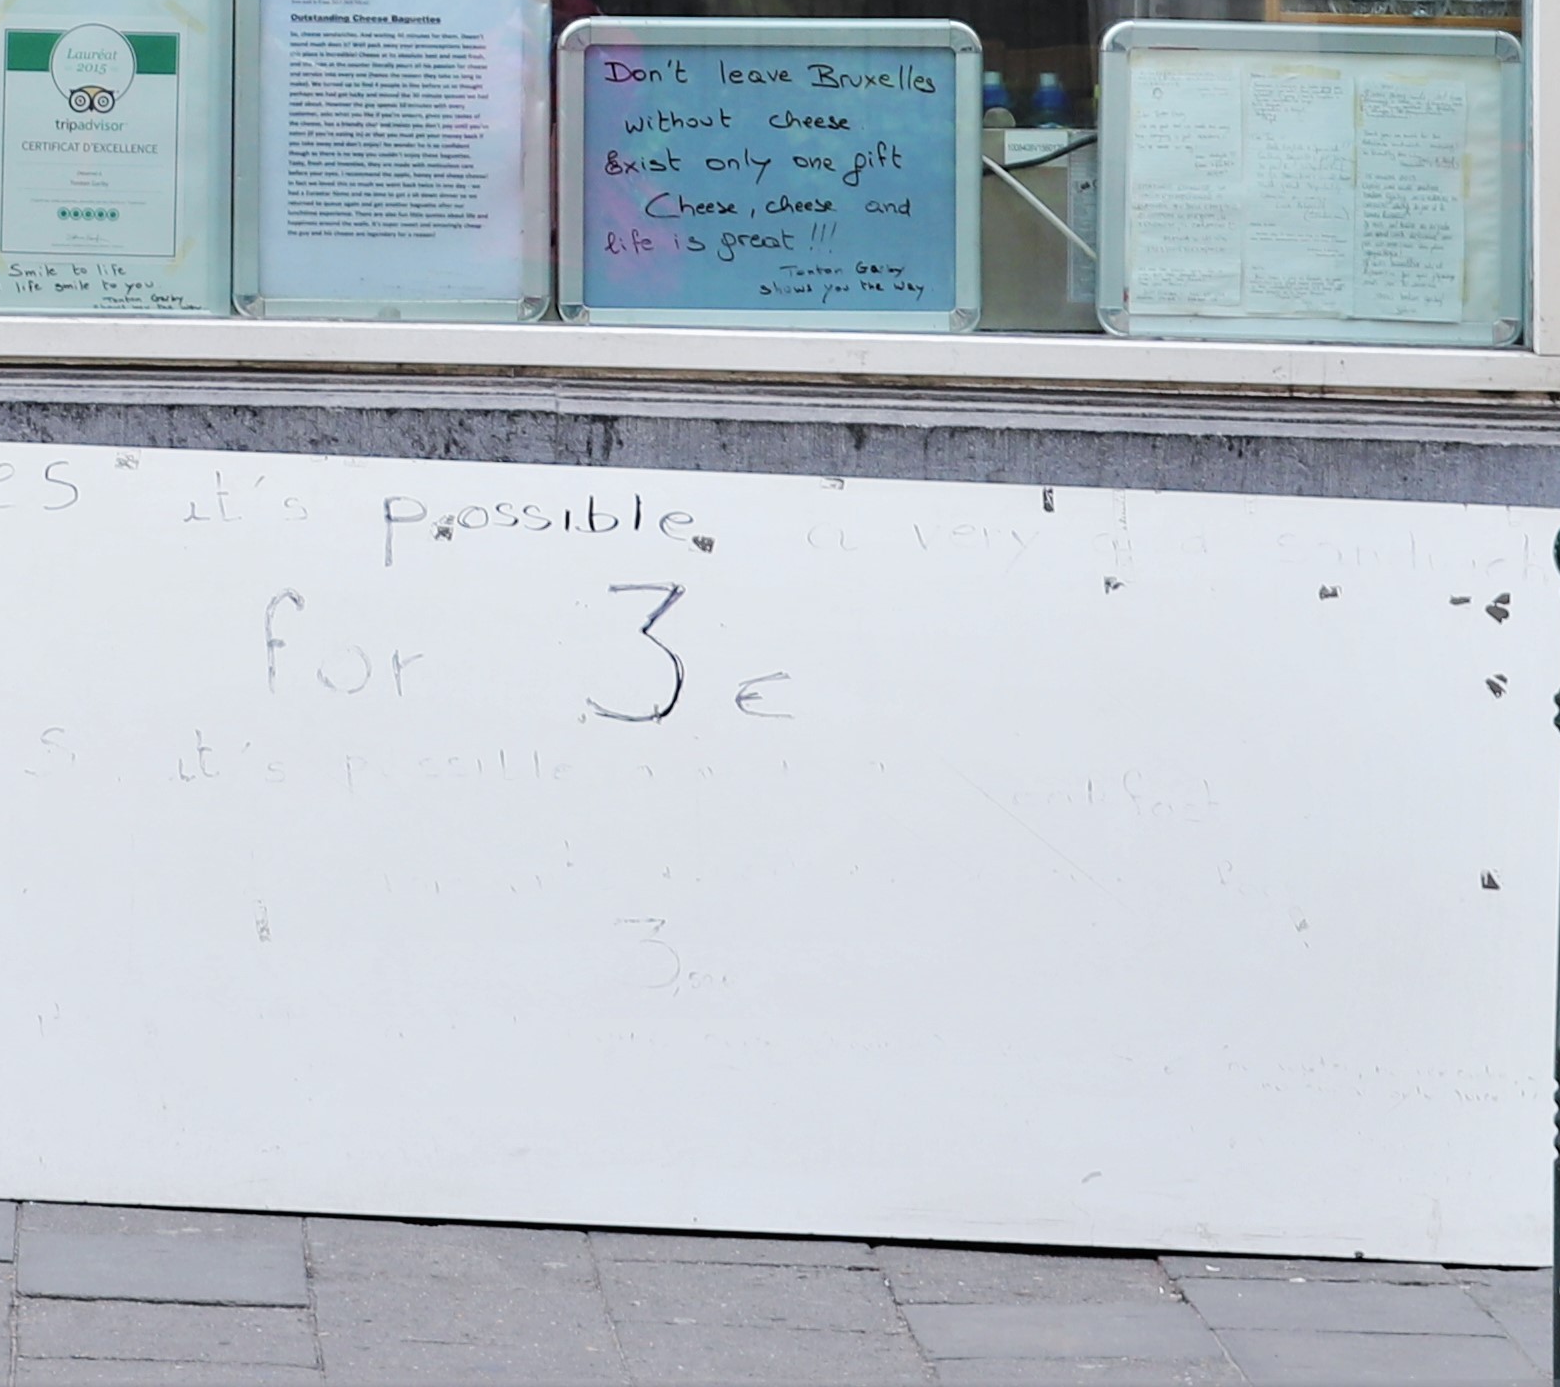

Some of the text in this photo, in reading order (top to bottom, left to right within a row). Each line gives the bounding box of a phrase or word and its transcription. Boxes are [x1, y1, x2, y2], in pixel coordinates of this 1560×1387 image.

[291, 13, 441, 25] Outstanding Cheese Baguettes
[66, 47, 118, 60] Lauréat
[76, 64, 108, 75] 2015
[604, 59, 937, 93] Don't leave Bruxelles
[55, 118, 124, 133] tripadvisor
[625, 108, 732, 134] without
[21, 140, 158, 155] CERTIFICAT D'EXCELLENCE
[604, 141, 903, 187] Exist only one gift
[765, 195, 837, 214] cheese
[865, 196, 912, 217] and
[604, 230, 653, 255] life
[674, 233, 706, 251] is
[717, 230, 794, 262] great
[8, 263, 127, 278] Smile to life
[15, 281, 42, 294] life
[55, 280, 90, 292] smile
[102, 280, 118, 291] to
[860, 279, 885, 292] the
[265, 588, 424, 698] for
[586, 581, 685, 723] 3
